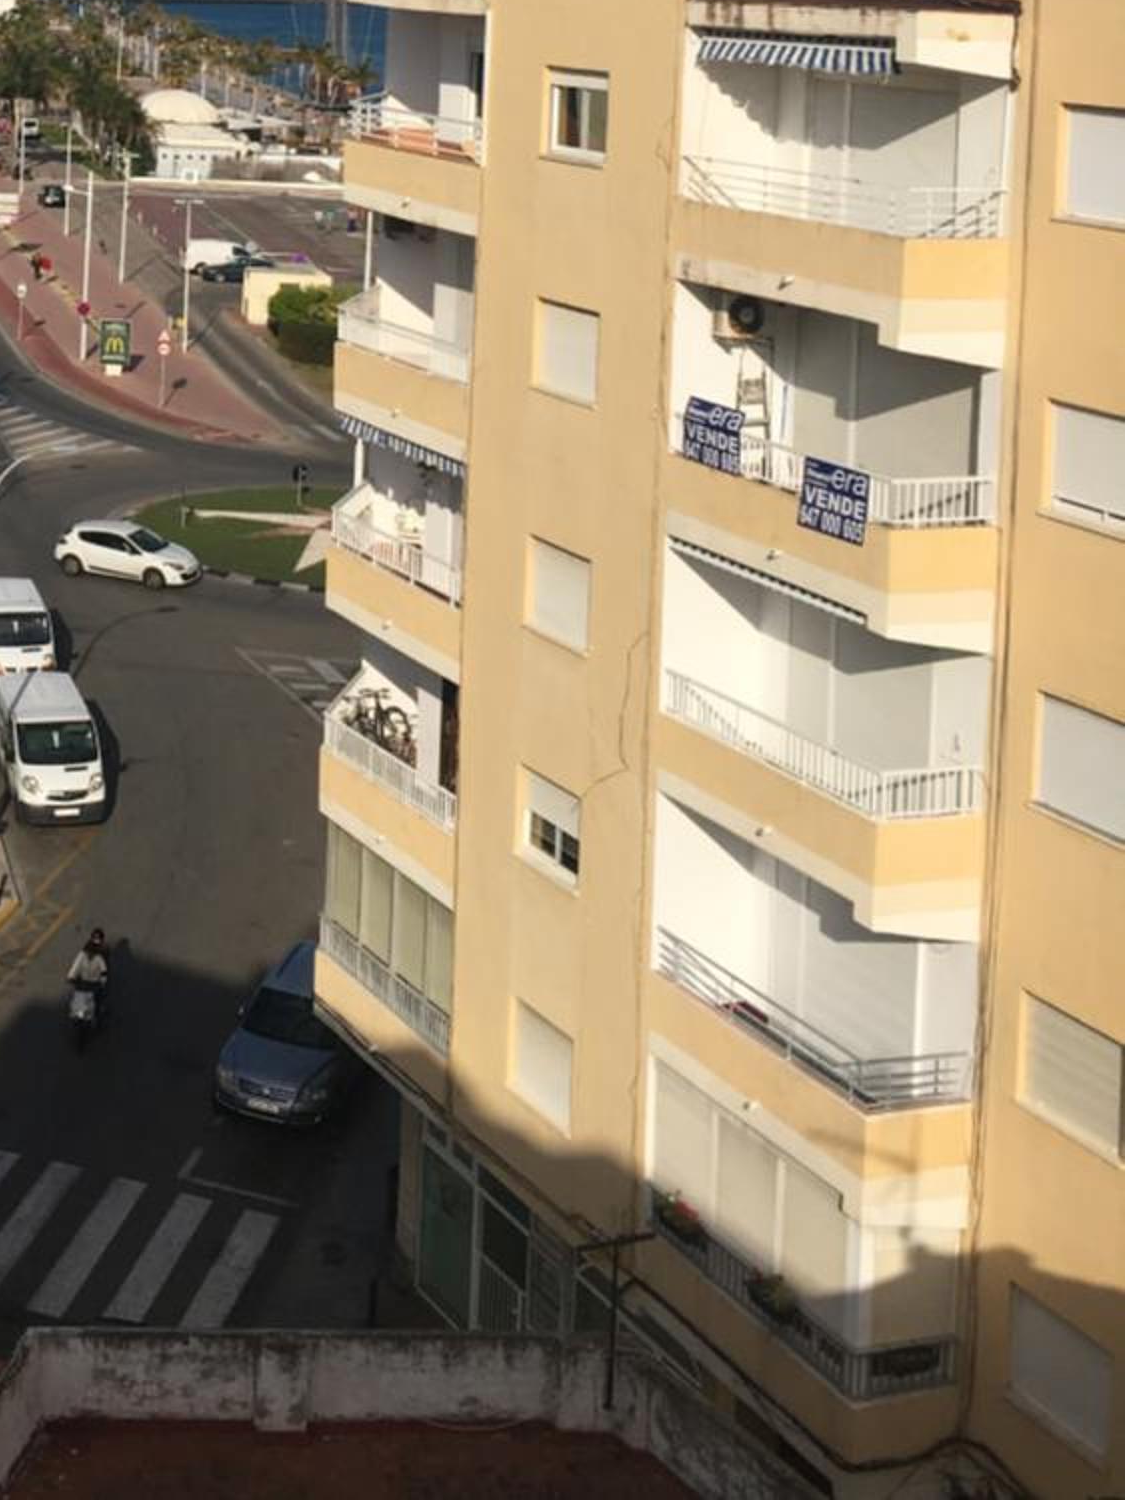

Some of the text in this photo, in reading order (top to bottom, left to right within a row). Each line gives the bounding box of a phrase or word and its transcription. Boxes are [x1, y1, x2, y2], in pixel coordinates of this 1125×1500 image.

[708, 406, 742, 431] era
[686, 421, 739, 454] VENDE
[831, 468, 867, 496] era
[804, 484, 866, 520] VENDE
